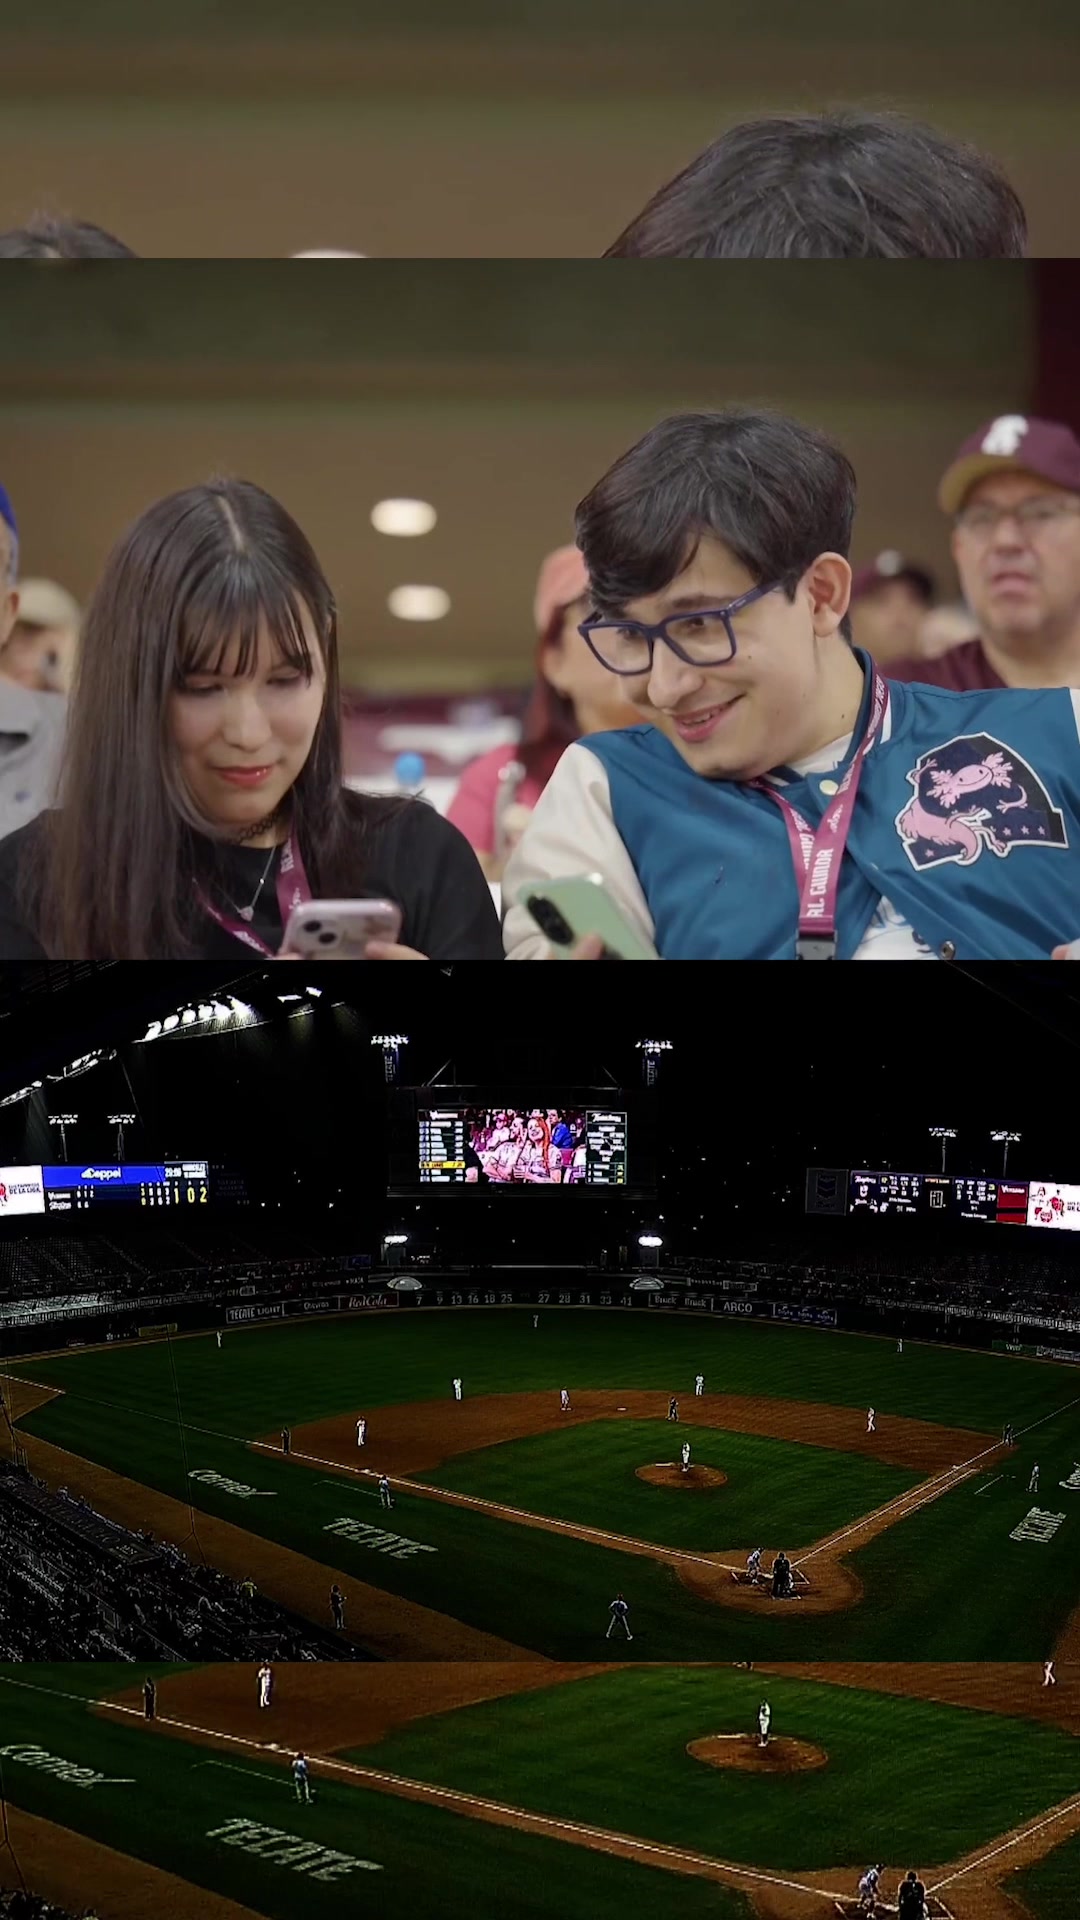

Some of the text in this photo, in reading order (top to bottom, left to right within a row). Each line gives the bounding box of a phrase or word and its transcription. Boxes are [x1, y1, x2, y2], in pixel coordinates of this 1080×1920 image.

[174, 1186, 207, 1204] 1 0 2
[415, 1294, 512, 1306] 7 9 13 16 18 25
[538, 1294, 550, 1303] 27
[579, 1295, 591, 1304] 31
[229, 1305, 280, 1320] TECATE LIGHT
[723, 1301, 752, 1313] ARCO
[322, 1517, 439, 1560] TECATE
[205, 1817, 384, 1882] TECATE
